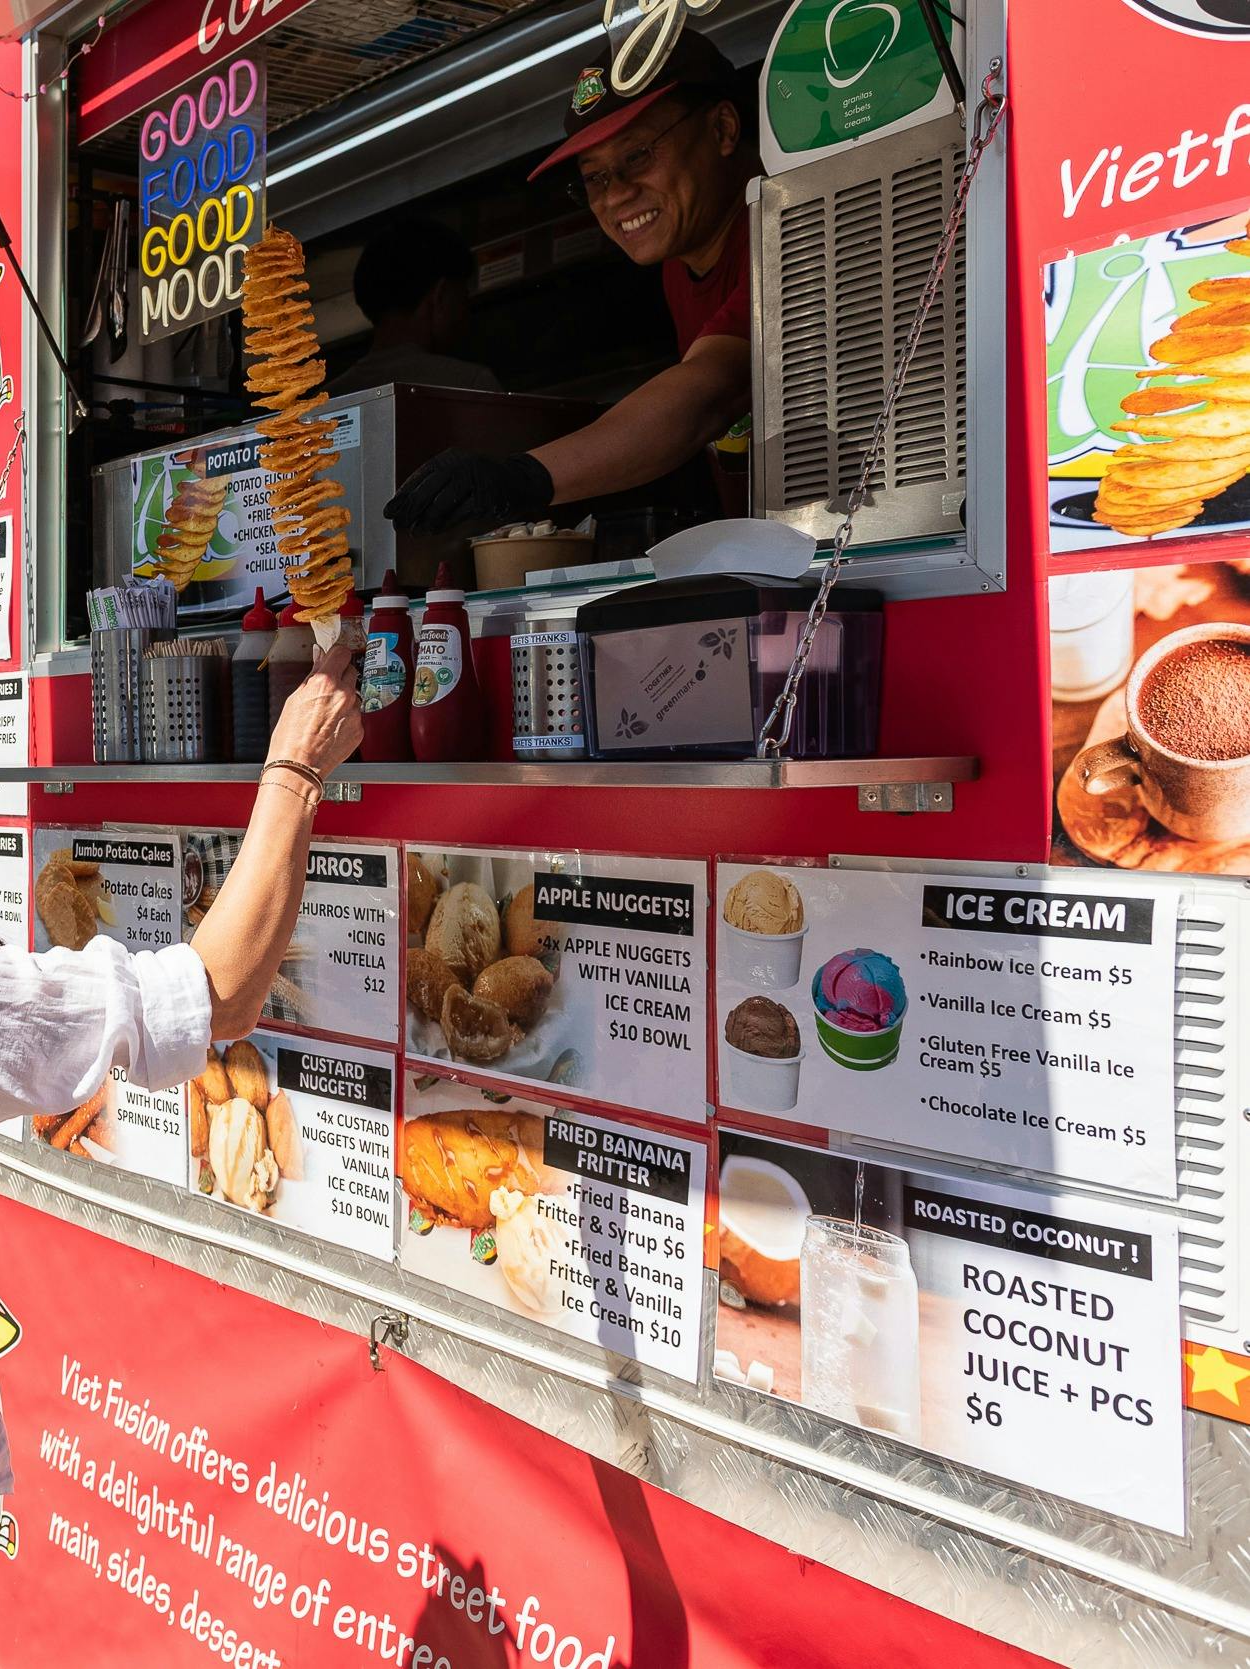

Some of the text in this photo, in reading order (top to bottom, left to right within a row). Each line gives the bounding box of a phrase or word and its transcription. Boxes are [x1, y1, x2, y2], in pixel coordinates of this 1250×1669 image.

[141, 59, 258, 162] GOOD
[842, 90, 873, 109] granitas
[844, 103, 871, 118] sorbets
[844, 115, 871, 129] creams
[142, 124, 256, 226] FOOD
[1060, 104, 1250, 219] Vietf
[142, 185, 254, 277] GOOD
[142, 243, 250, 336] MOOD
[207, 448, 250, 471] POTATO
[227, 476, 261, 495] POTATO
[260, 541, 276, 556] SEA
[250, 557, 278, 574] CHILLI
[532, 633, 568, 643] THANKS
[535, 738, 571, 746] THANKS
[75, 843, 171, 862] Jumbo Potato Cakes
[306, 855, 363, 878] URROS
[3, 890, 23, 905] FRIES
[104, 879, 173, 900] Potato Cakes
[537, 886, 690, 919] APPLE NUGGETS!
[4, 910, 23, 923] BOWL
[137, 904, 172, 923] $4 Each
[353, 907, 385, 923] WITH
[945, 892, 1126, 932] ICE CREAM
[126, 927, 172, 945] 3x for $10
[352, 930, 385, 946] ICING
[542, 935, 691, 968] 4x APPLE NUGGETS
[333, 950, 386, 970] NUTELLA
[928, 950, 1133, 985] Rainbow Ice Cream $5
[364, 976, 386, 993] $12
[578, 962, 691, 994] WITH VANILLA
[605, 994, 691, 1022] ICE CREAM
[927, 992, 1112, 1029] Vanilla Ice Cream $5
[609, 1019, 691, 1051] $10 BOWL
[302, 1055, 365, 1080] CUSTARD
[919, 1052, 1002, 1078] Cream $5
[928, 1036, 1135, 1078] Gluten Free Vanilla Ice
[300, 1072, 367, 1100] NUGGETS!
[126, 1091, 151, 1108] WITH
[154, 1098, 179, 1115] ICING
[117, 1109, 180, 1135] SPRINKLE $12
[320, 1110, 389, 1138] 4x CUSTARD
[928, 1095, 1147, 1147] Chocolate Ice Cream $5
[302, 1125, 390, 1159] NUGGETS WITH
[549, 1119, 685, 1173] FRIED BANANA
[342, 1156, 390, 1181] VANILLA
[577, 1150, 650, 1187] FRITTER
[328, 1175, 390, 1204] ICE CREAM
[331, 1198, 352, 1217] $10
[356, 1207, 390, 1228] BOWL
[573, 1183, 685, 1232] Fried Banana
[537, 1199, 685, 1260] Fritter & Syrup $6
[914, 1200, 1125, 1260] ROASTED COCONUT
[571, 1239, 684, 1292] Fried Banana
[550, 1259, 683, 1320] Fritter & Vanilla
[963, 1263, 1114, 1321] ROASTED
[561, 1290, 681, 1348] Ice Cream $10
[963, 1308, 1130, 1373] COCONUT
[963, 1351, 1154, 1426] JUICE + PCS
[966, 1392, 1003, 1427] $6
[61, 1354, 616, 1669] Viet Fusion offers delicious street food
[40, 1428, 81, 1480] with
[82, 1460, 97, 1491] a
[99, 1459, 215, 1559] delightful
[216, 1535, 287, 1609] range
[290, 1578, 332, 1627] of
[49, 1512, 102, 1578] main,
[107, 1548, 175, 1626] sides,
